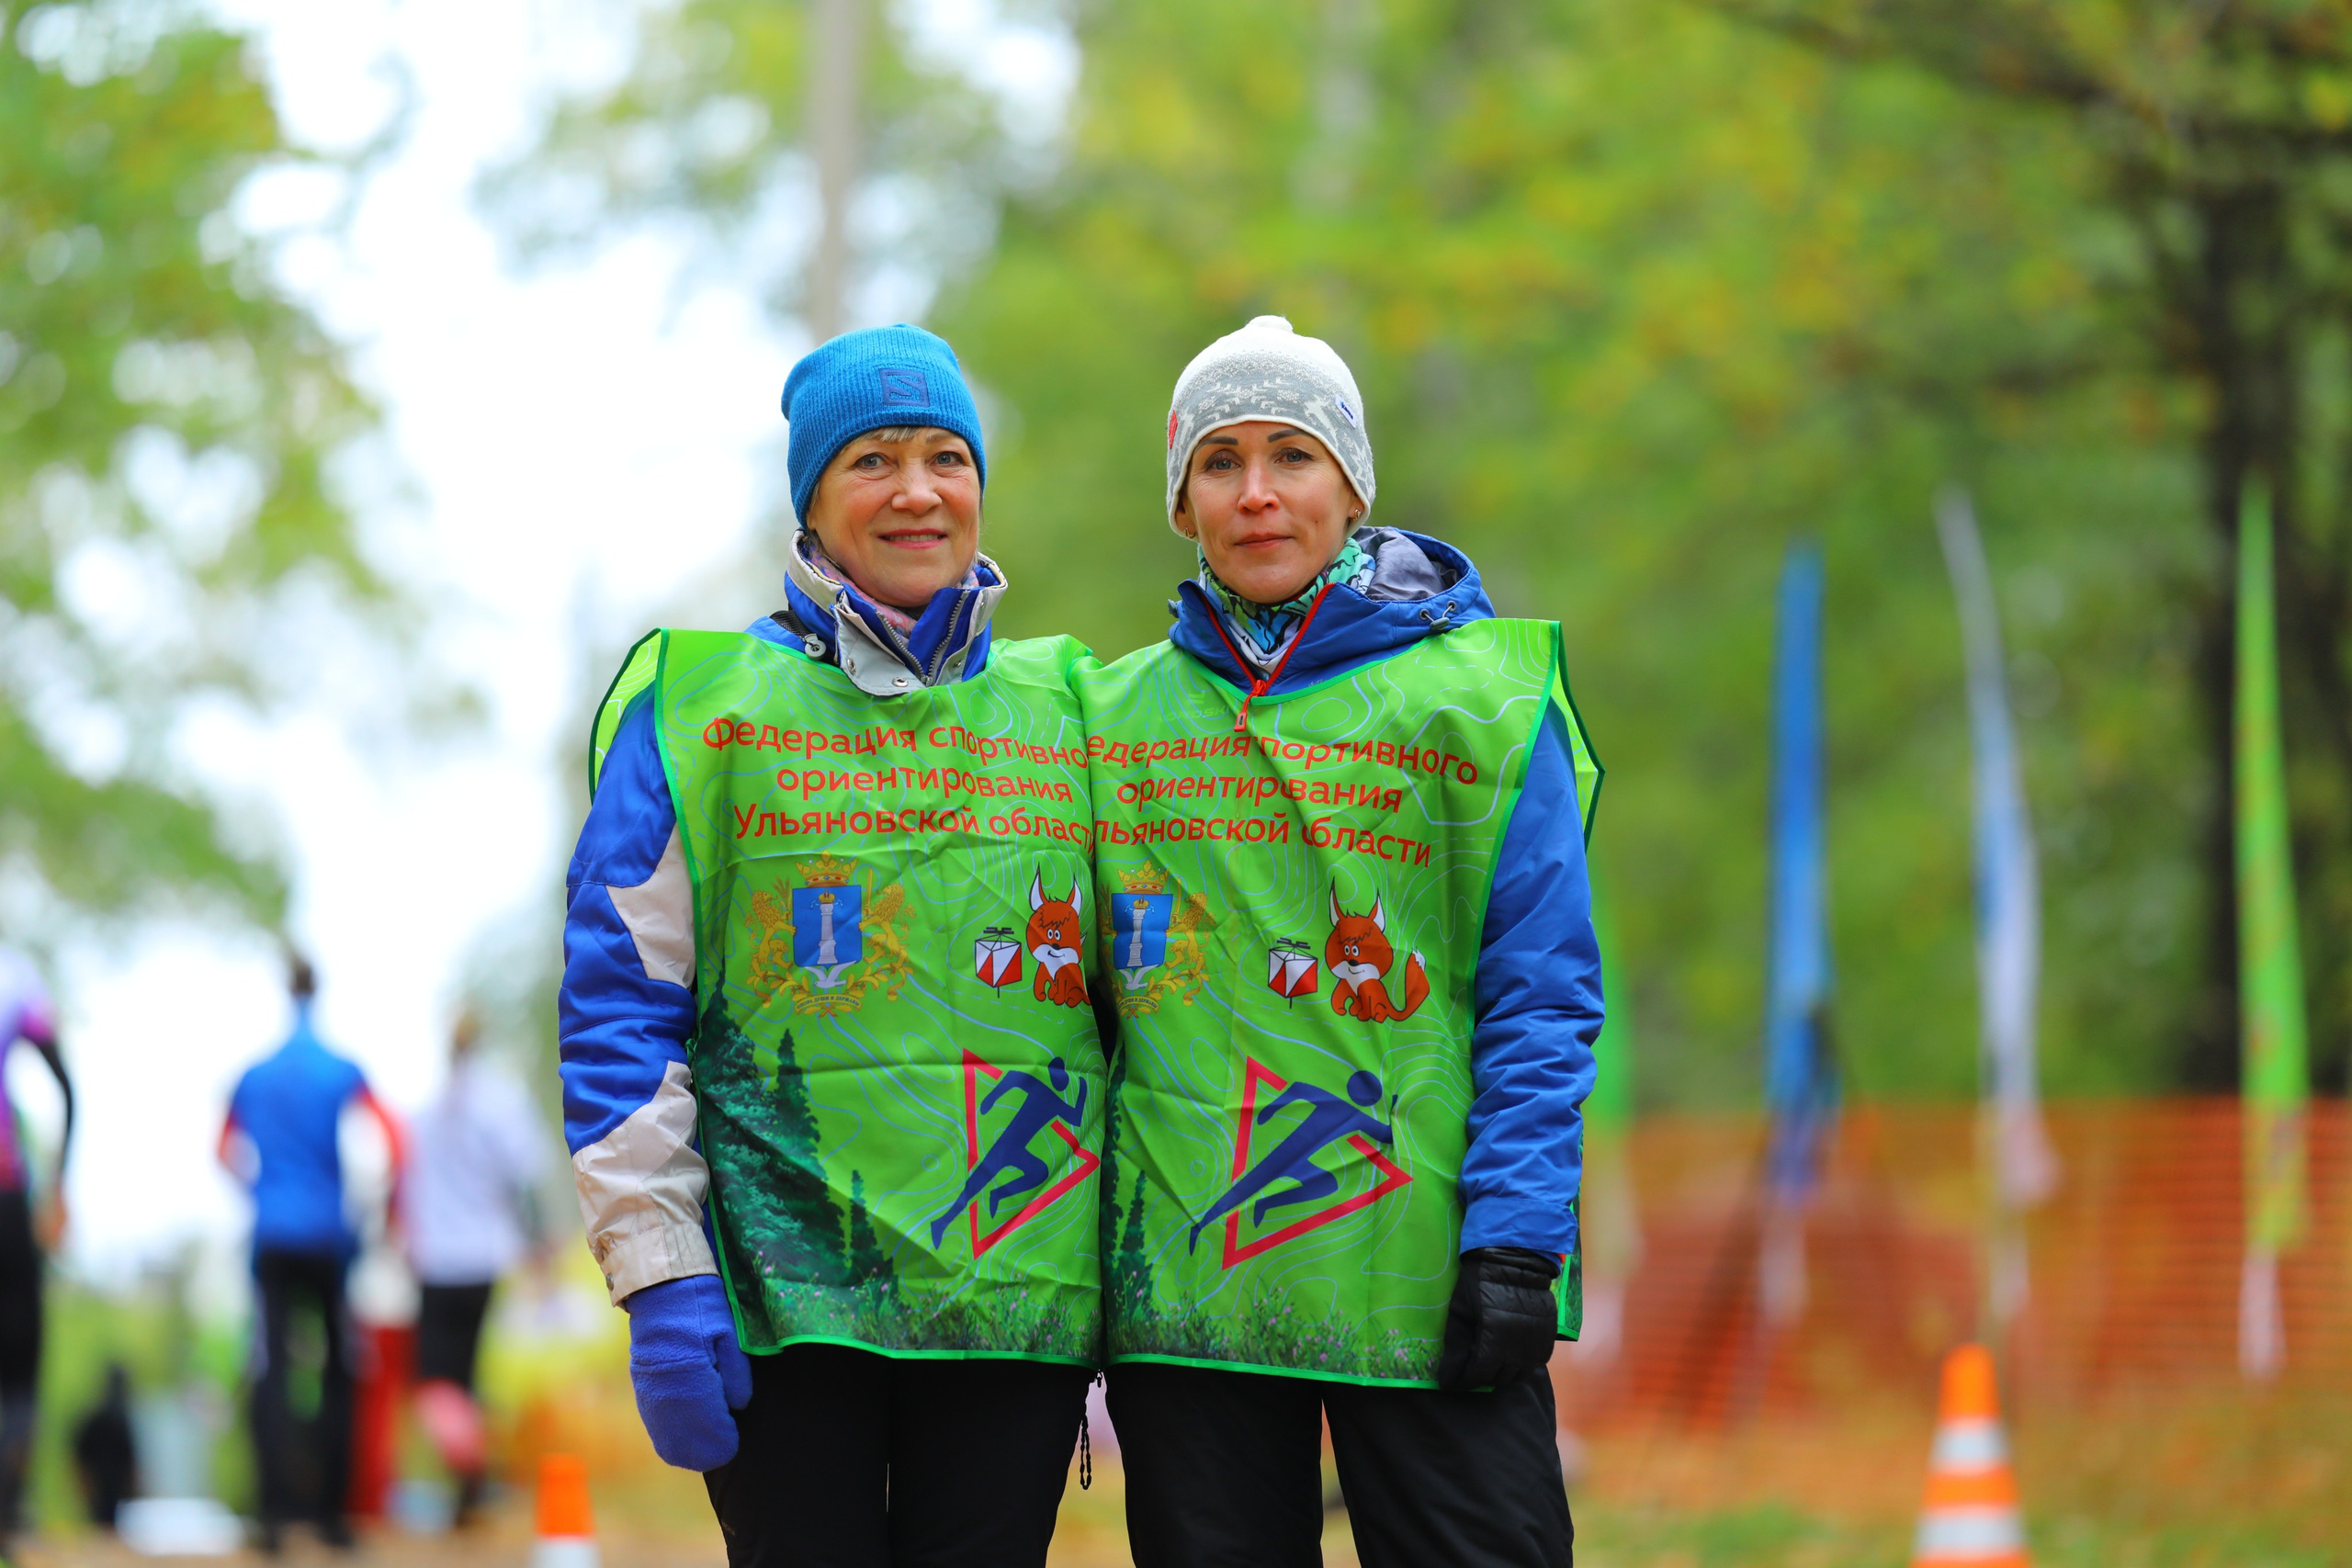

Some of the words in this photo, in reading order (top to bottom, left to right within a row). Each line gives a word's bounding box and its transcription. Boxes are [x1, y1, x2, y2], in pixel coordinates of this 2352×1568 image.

[703, 716, 917, 760] Федерация
[776, 765, 1074, 804] ориентирования
[733, 802, 980, 839] Ульяновской
[1093, 812, 1290, 846] льяновской
